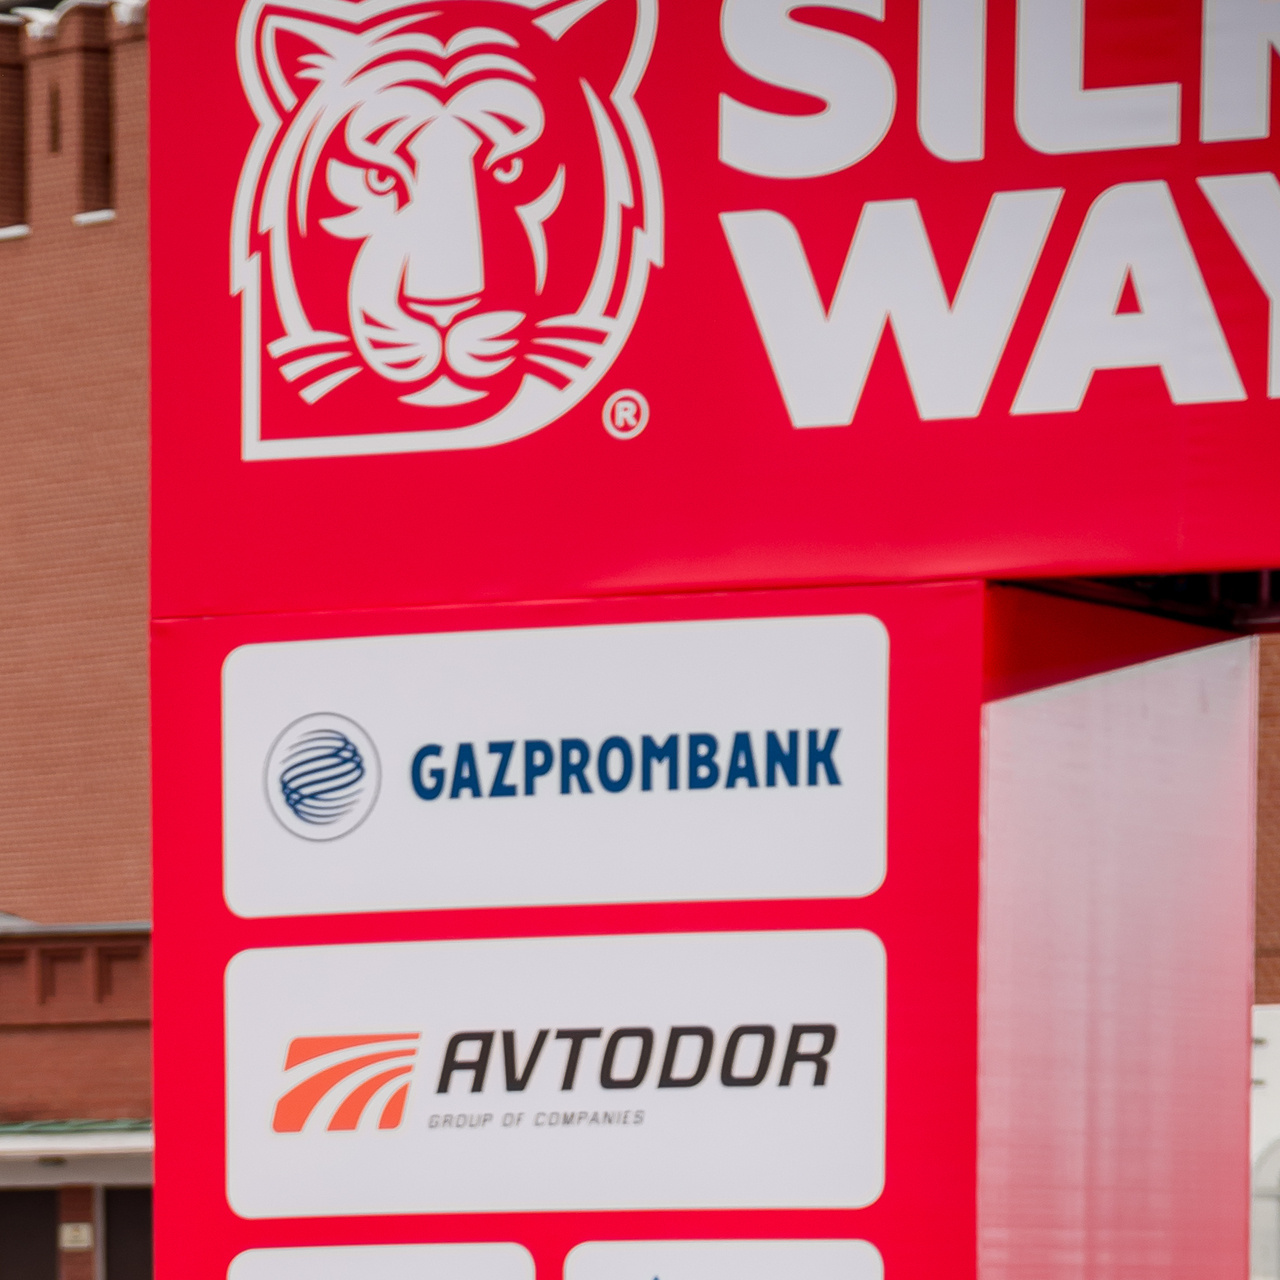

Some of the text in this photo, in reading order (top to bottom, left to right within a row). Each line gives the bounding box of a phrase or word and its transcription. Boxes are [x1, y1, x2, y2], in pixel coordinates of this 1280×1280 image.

[411, 728, 842, 801] GAZPROMBANK
[435, 1023, 839, 1095] AVTODOR
[428, 1109, 646, 1130] GROUP OF COMPANIES
